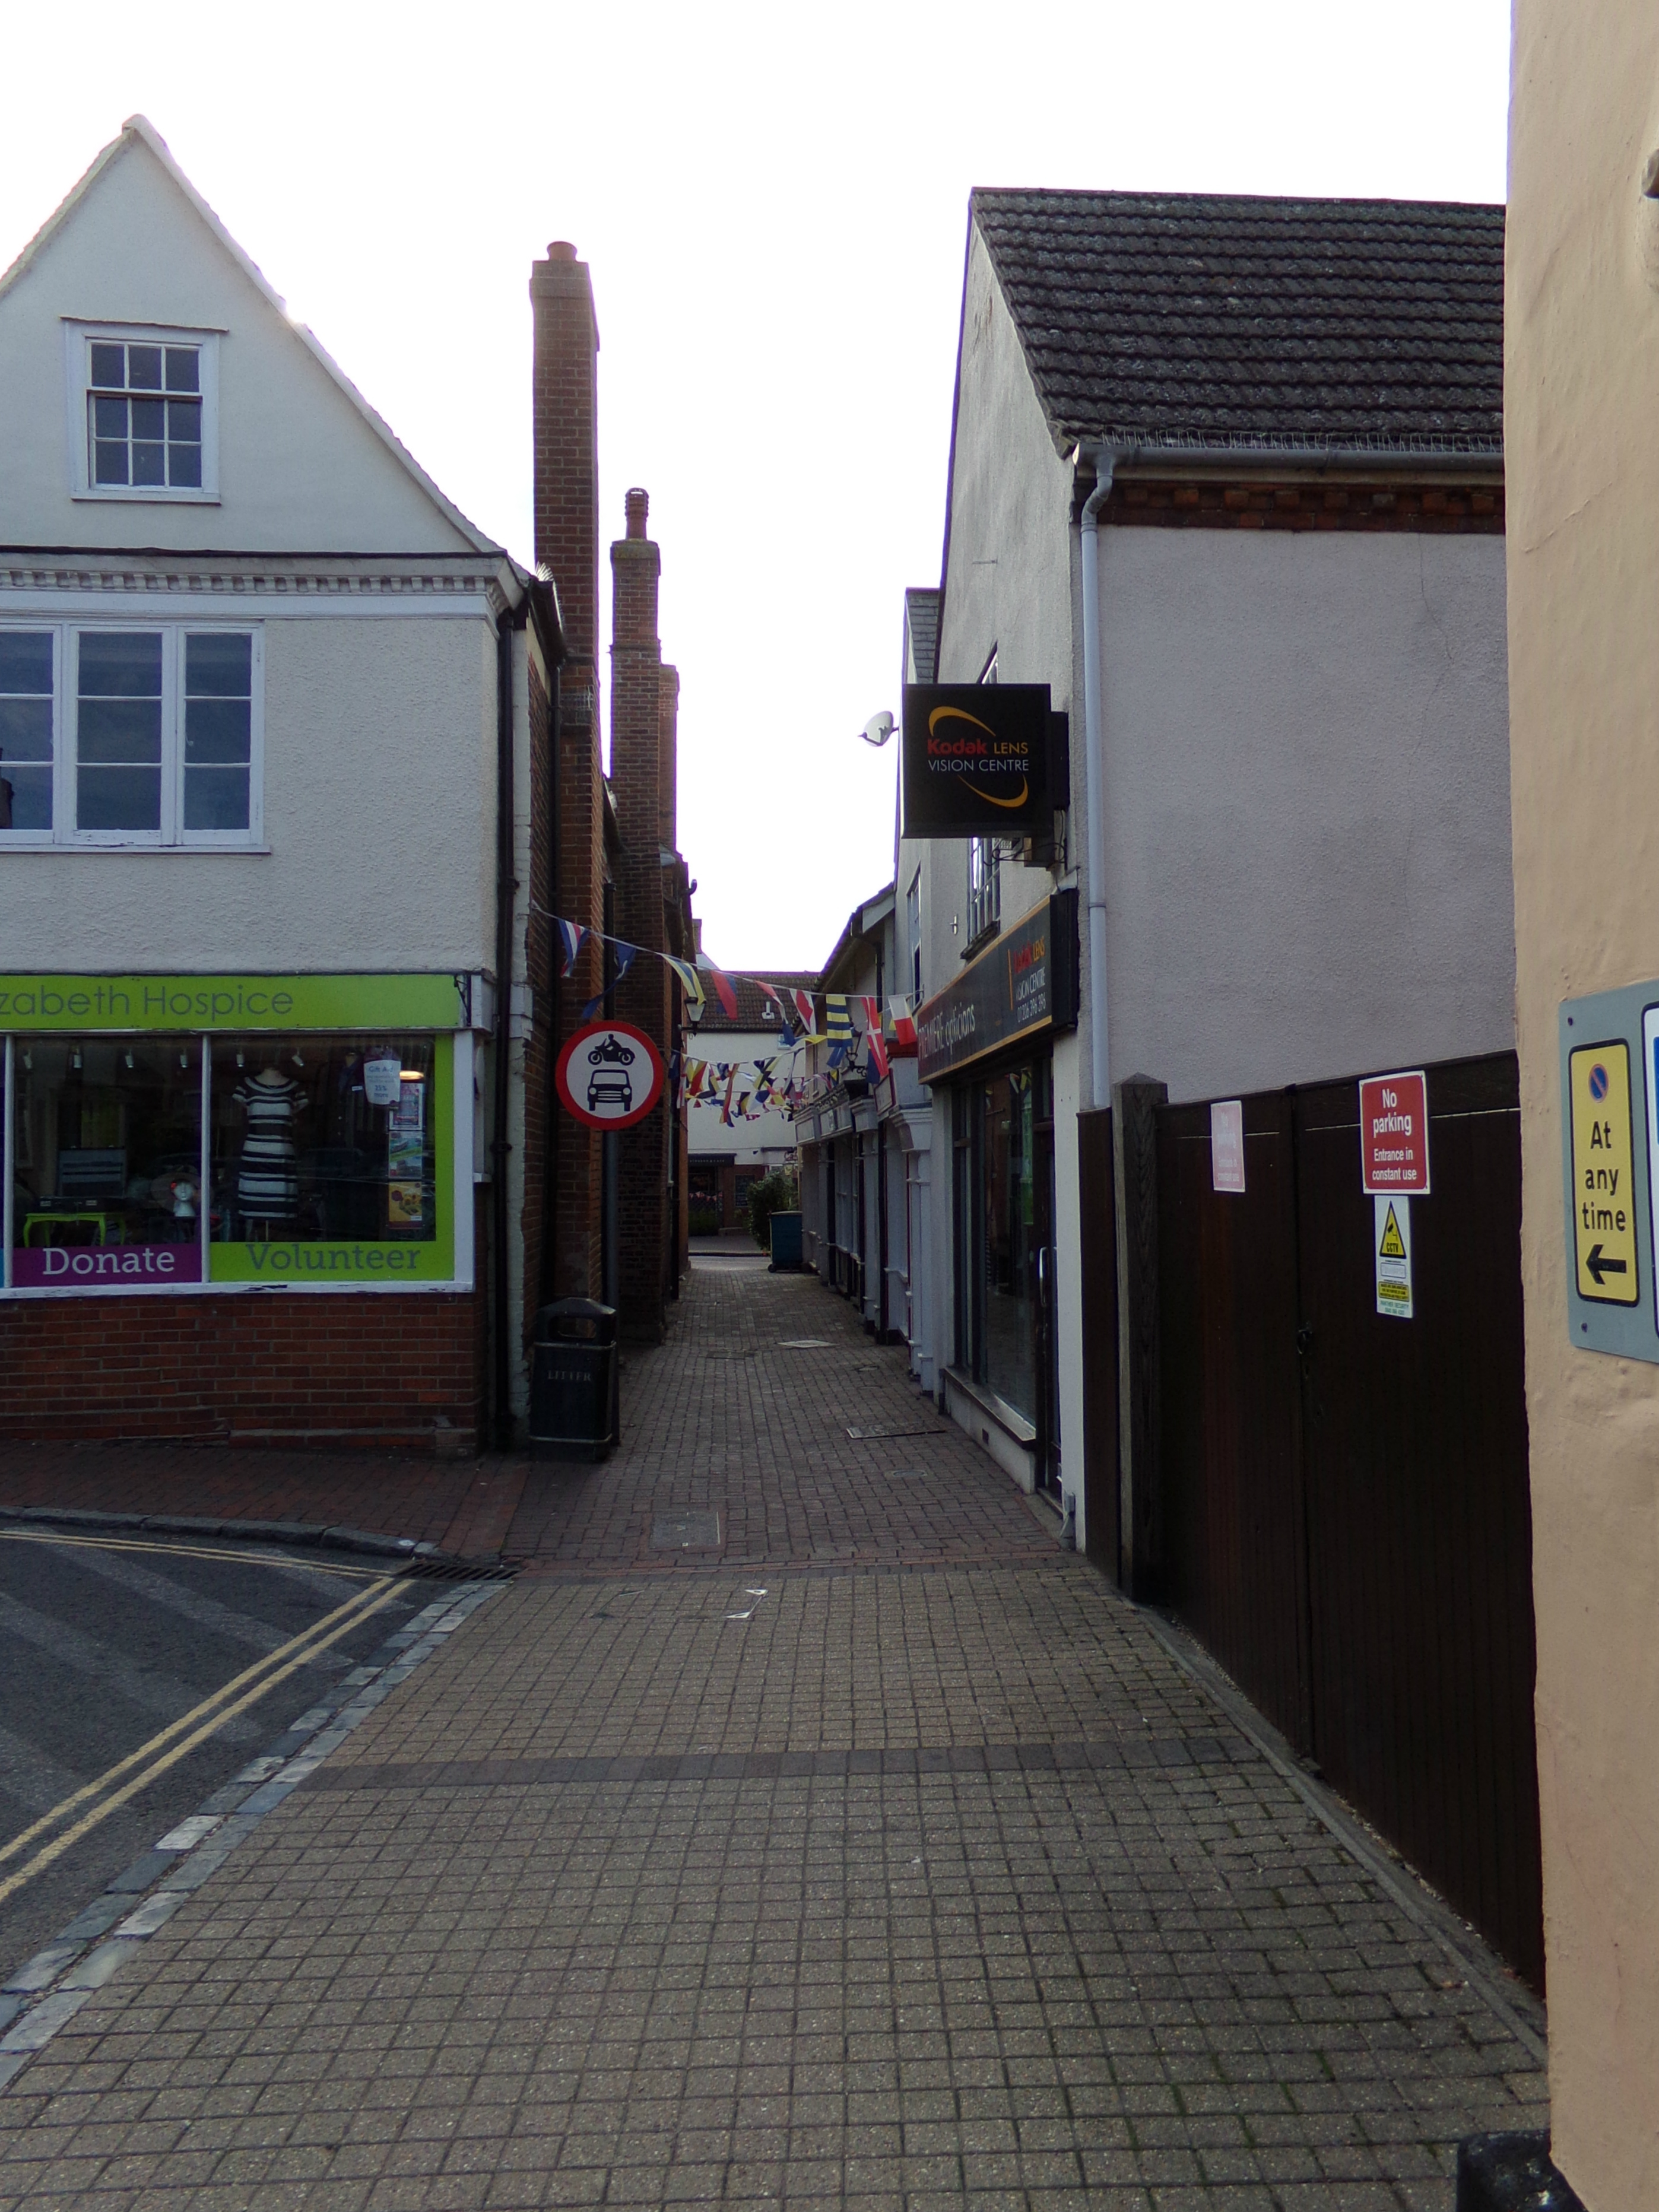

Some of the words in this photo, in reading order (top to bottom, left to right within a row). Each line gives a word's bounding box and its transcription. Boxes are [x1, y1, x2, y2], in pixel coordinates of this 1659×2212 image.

[927, 738, 988, 755] Kodak
[994, 742, 1028, 754] LENS
[928, 759, 974, 772] VISION
[979, 759, 1029, 772] CENTRE
[1032, 935, 1045, 962] LENS
[1029, 966, 1045, 994] CENTRE
[144, 984, 294, 1022] Hospice
[945, 1002, 975, 1055] opticians
[1382, 1088, 1397, 1109] No
[1373, 1112, 1412, 1138] parking
[1590, 1120, 1612, 1149] At
[1373, 1148, 1404, 1161] Entrance
[1406, 1147, 1413, 1160] in
[1372, 1167, 1401, 1180] constant
[1403, 1169, 1417, 1180] use
[1585, 1169, 1619, 1196] any
[1582, 1201, 1626, 1232] time
[245, 1243, 421, 1270] Volunteer
[1387, 1242, 1399, 1253] CCTV
[43, 1248, 175, 1274] Donate
